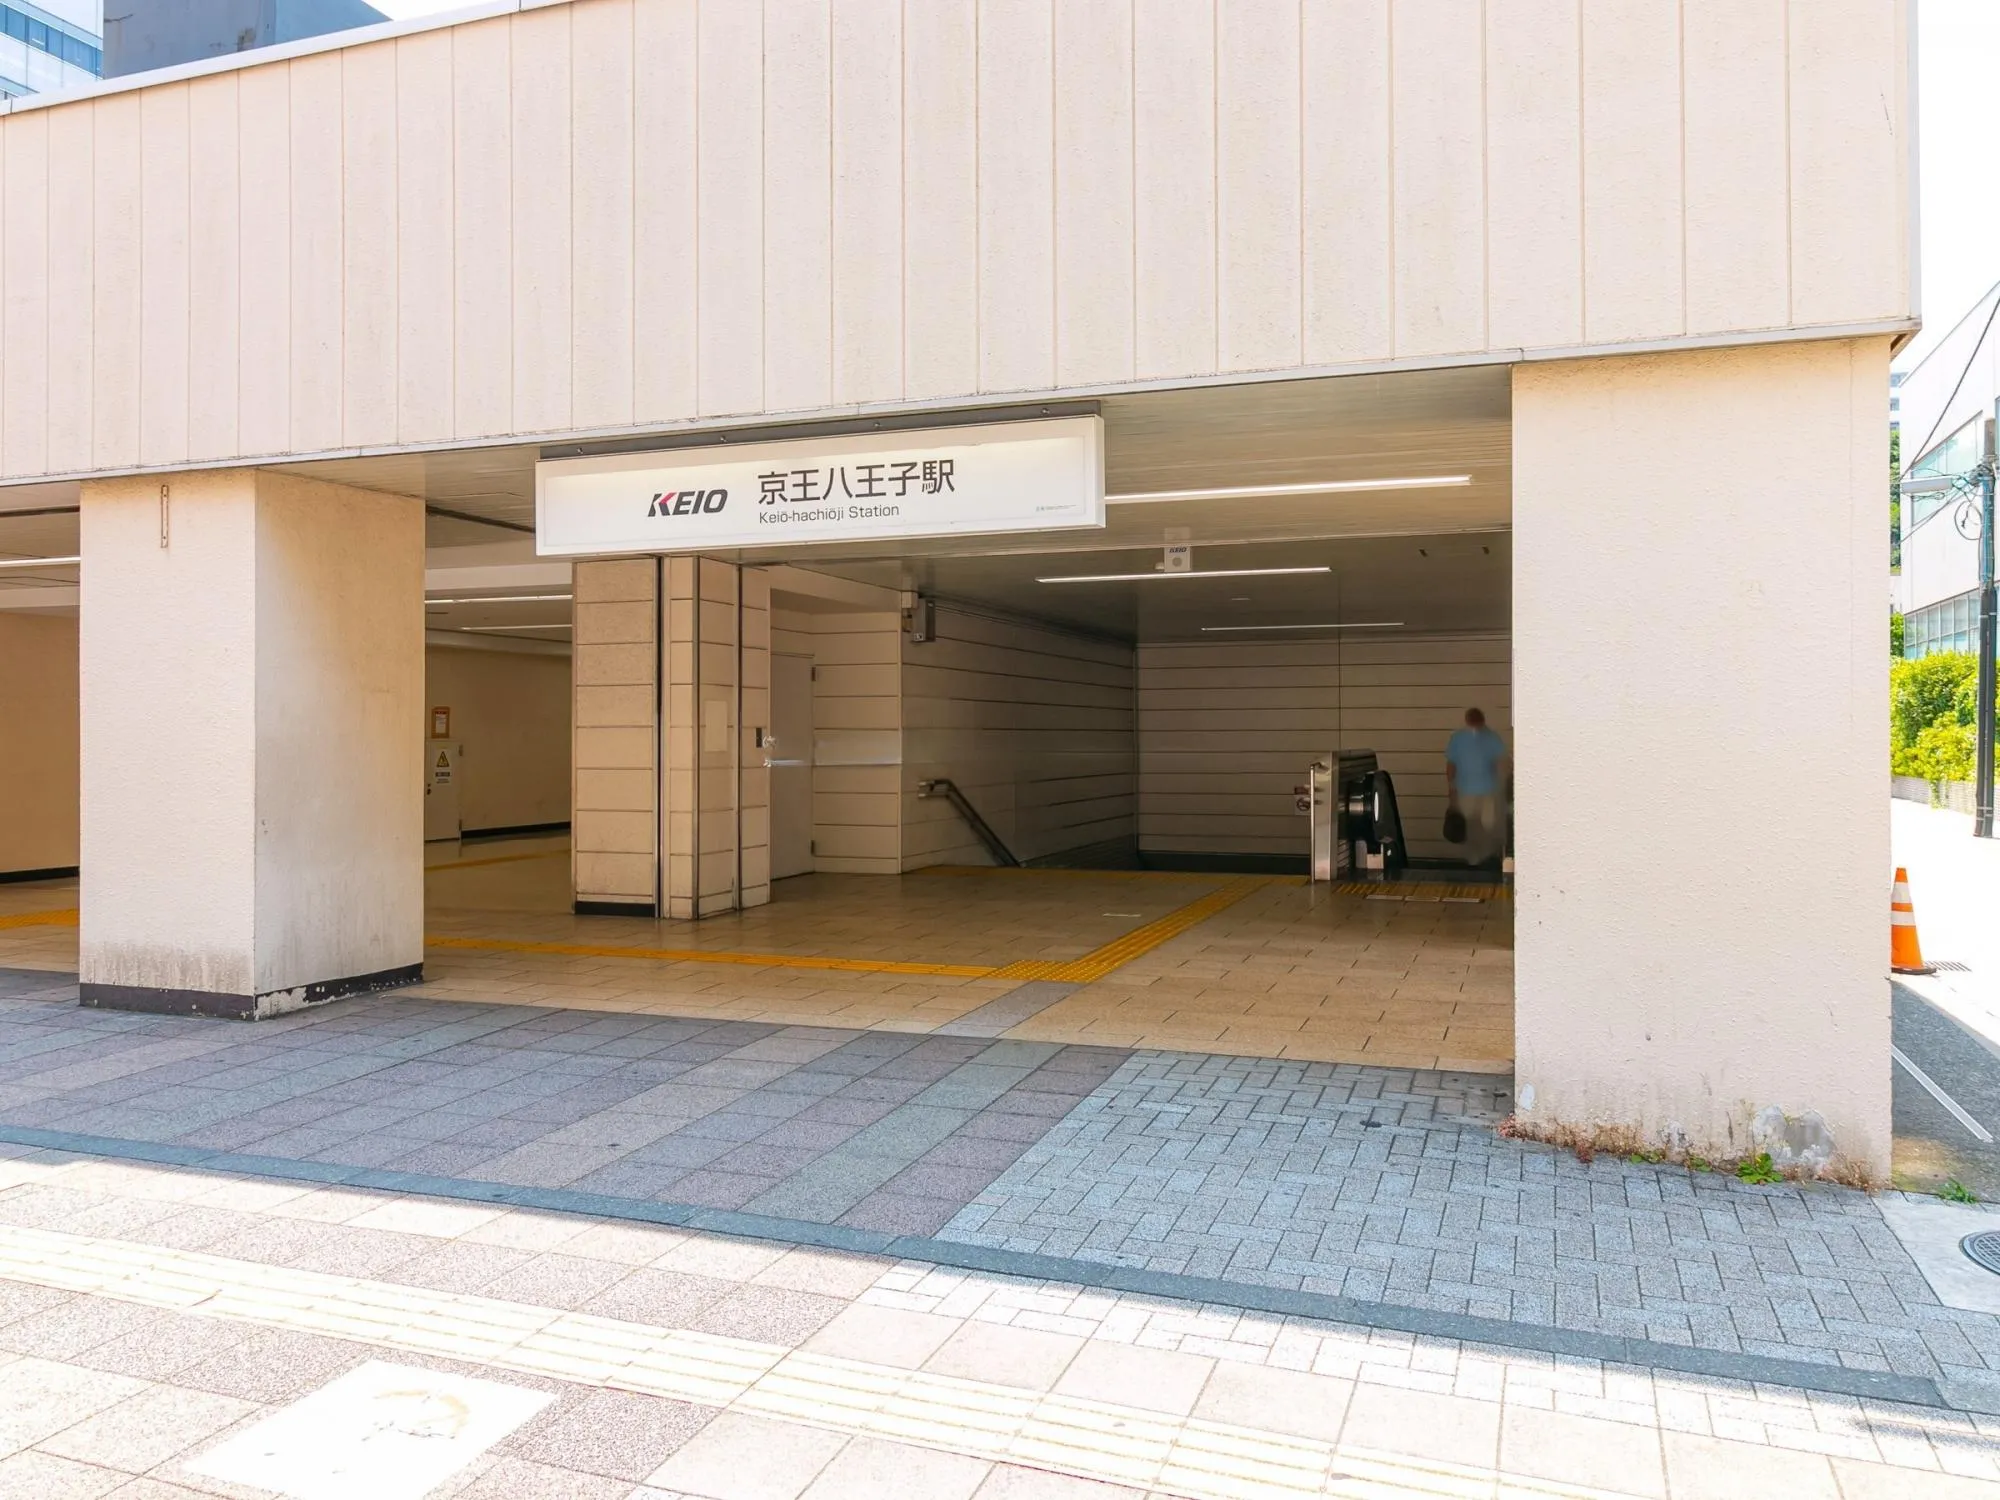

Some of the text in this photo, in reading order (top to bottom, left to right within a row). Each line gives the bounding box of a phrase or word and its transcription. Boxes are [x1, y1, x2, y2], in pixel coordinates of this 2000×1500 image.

[757, 458, 956, 506] 京王八王子駅
[647, 488, 729, 518] KEIO
[848, 503, 900, 519] Station
